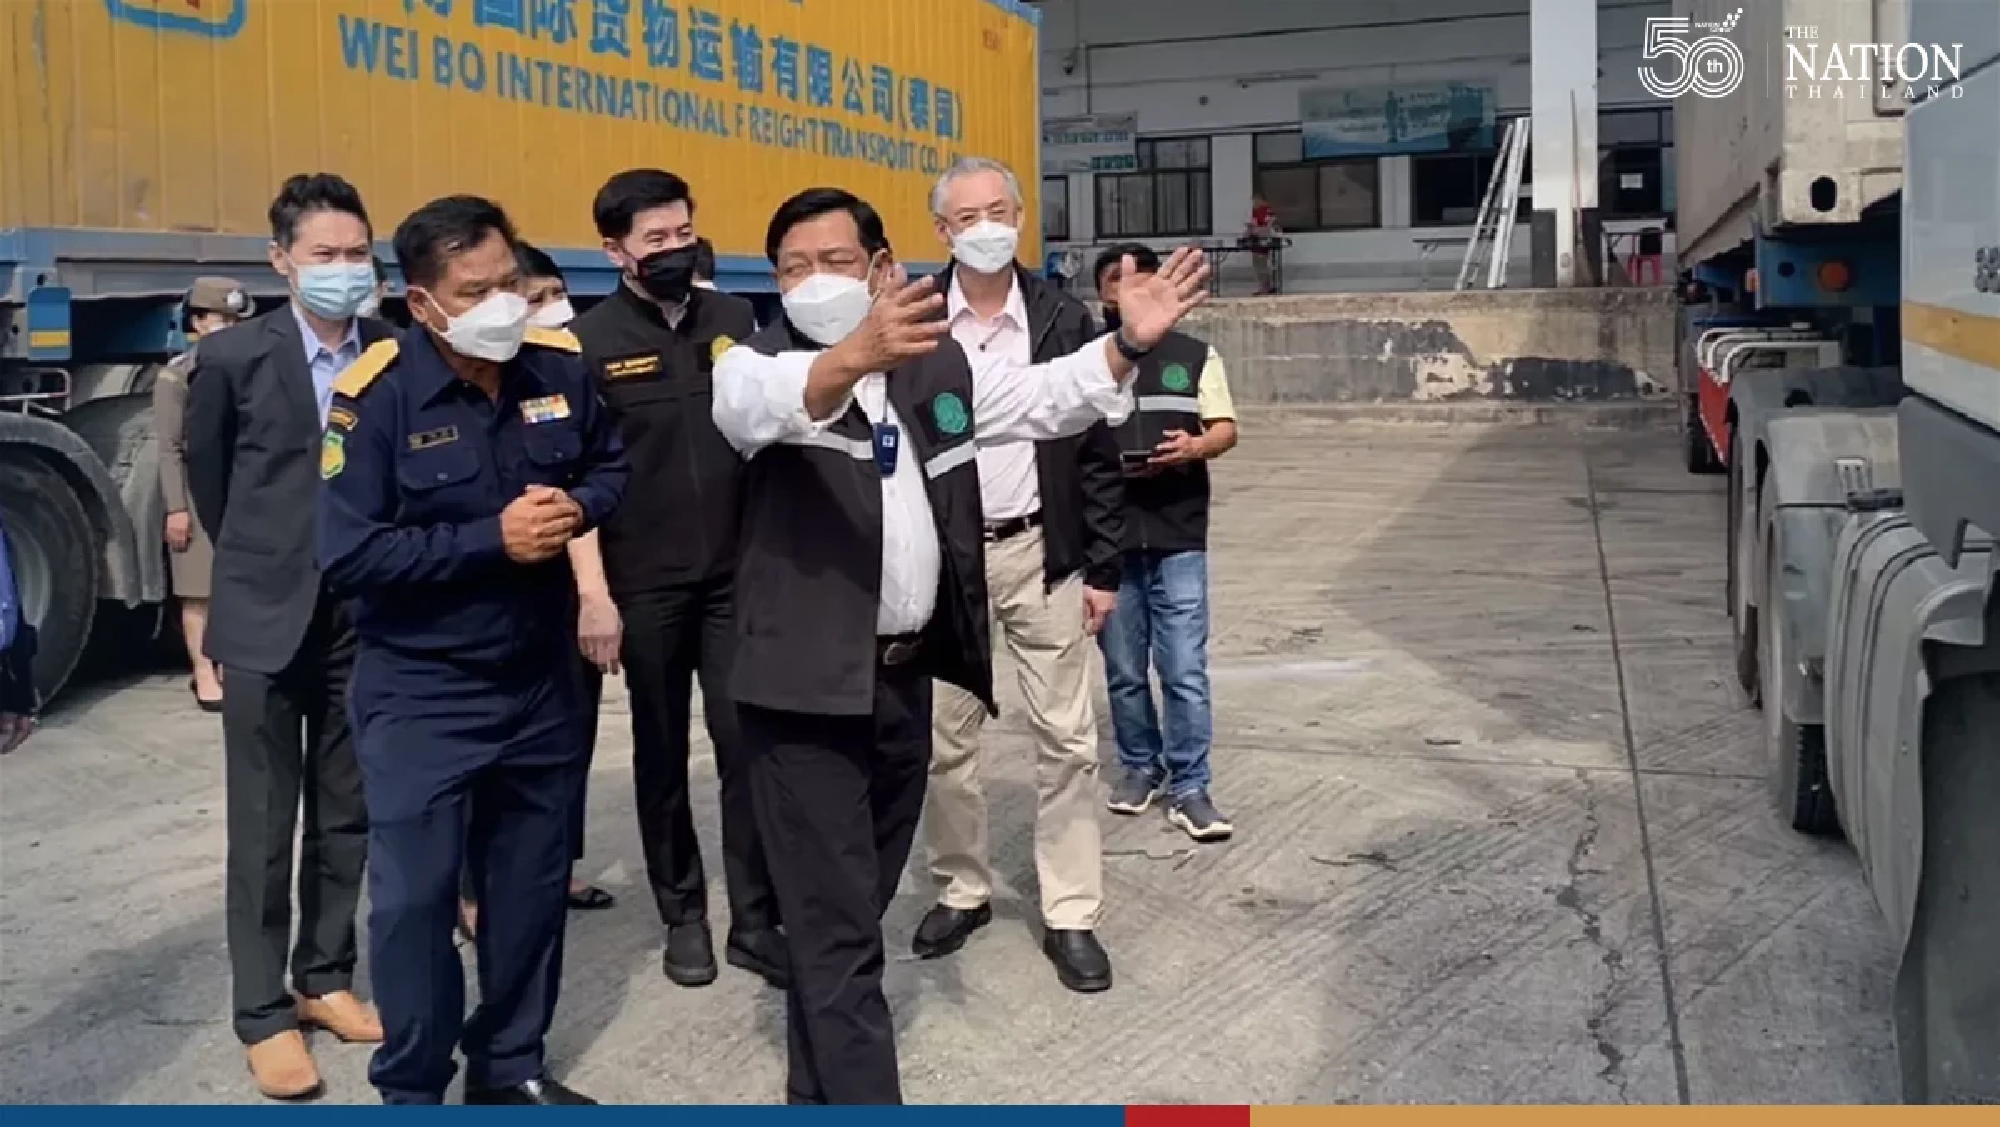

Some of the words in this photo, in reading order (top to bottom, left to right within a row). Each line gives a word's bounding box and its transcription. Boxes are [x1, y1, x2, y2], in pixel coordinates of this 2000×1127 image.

[338, 12, 418, 80] WEI
[432, 34, 486, 92] BO
[496, 50, 729, 138] INTERNATIONAL
[734, 102, 820, 153] FREIGHT
[820, 116, 916, 172] TRANSPORT
